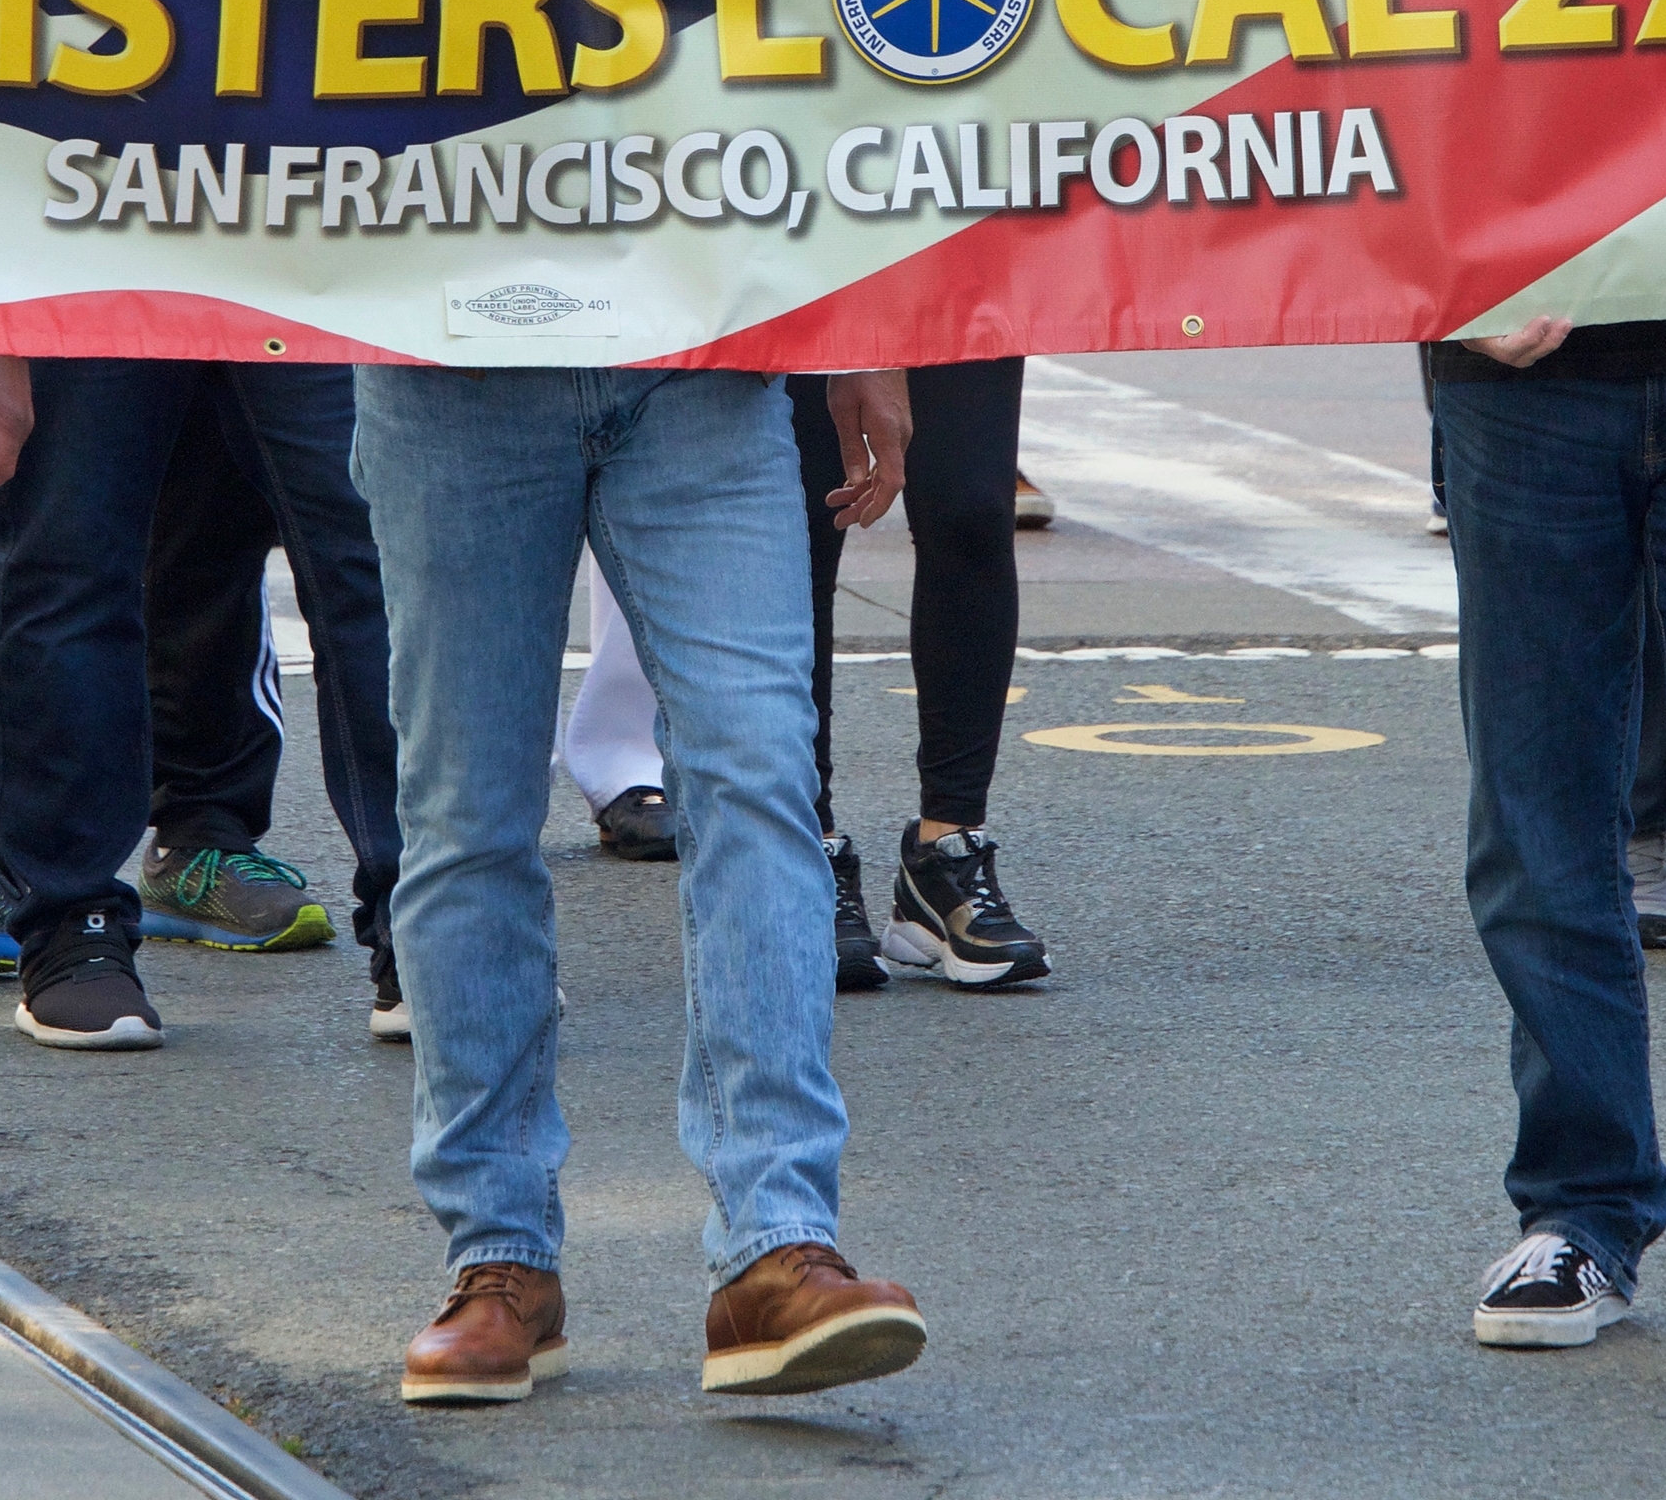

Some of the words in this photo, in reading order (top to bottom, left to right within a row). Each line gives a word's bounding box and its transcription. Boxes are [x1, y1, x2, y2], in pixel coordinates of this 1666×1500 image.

[43, 137, 247, 225] SAN
[264, 130, 808, 230] FRANCISCO,
[825, 107, 1397, 214] CALIFORNIA
[488, 285, 518, 301] ALLIED
[518, 285, 561, 300] PRINTING
[470, 302, 509, 310] TRADES
[540, 301, 579, 310] COUNCIL
[587, 299, 612, 311] 401
[488, 312, 535, 325] NORTHERN
